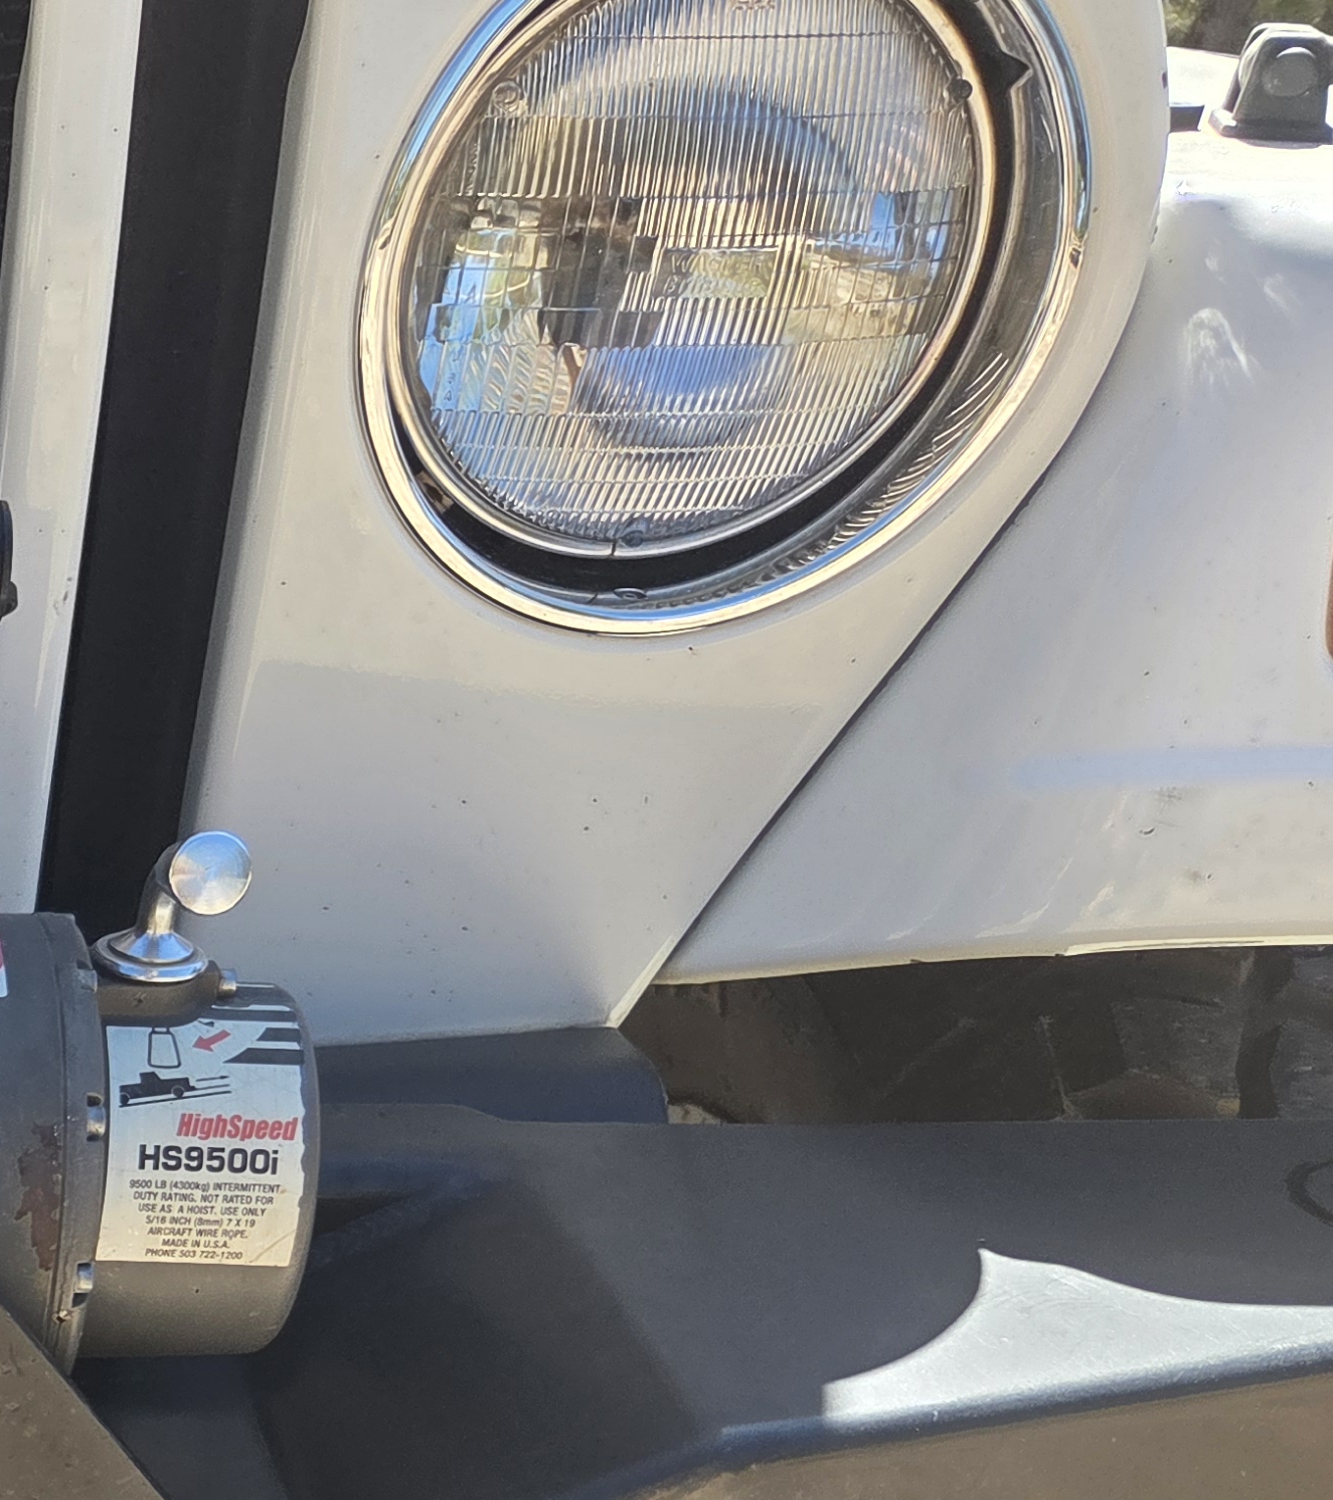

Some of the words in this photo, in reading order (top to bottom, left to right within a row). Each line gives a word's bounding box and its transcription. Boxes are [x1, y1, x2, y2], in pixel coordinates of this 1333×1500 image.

[176, 1113, 299, 1142] HighSpeed
[138, 1144, 279, 1175] HS9500i
[129, 1180, 152, 1189] 9500
[155, 1180, 167, 1189] LB
[169, 1181, 210, 1192] (4300kg)
[213, 1182, 281, 1194] INTERMITTENT
[133, 1191, 158, 1200] DUTY
[160, 1191, 197, 1202] RATING.
[200, 1194, 219, 1203] NOT
[222, 1194, 252, 1204] RATED
[255, 1196, 274, 1205] FOR
[138, 1203, 156, 1213] USE
[159, 1204, 172, 1214] AS
[177, 1205, 184, 1214] A
[186, 1205, 217, 1215] HOIST.
[220, 1206, 238, 1216] USE
[241, 1207, 267, 1217] ONLY
[145, 1215, 166, 1225] 5/16
[169, 1216, 191, 1226] INCH
[193, 1217, 223, 1229] (8mm)
[226, 1218, 233, 1227] 7
[234, 1218, 242, 1227] X
[244, 1218, 256, 1228] 19
[147, 1227, 192, 1237] AIRCRAFT
[195, 1228, 219, 1238] WIRE
[221, 1229, 248, 1240] ROPE.
[161, 1238, 188, 1248] MADE
[191, 1239, 201, 1248] IN
[145, 1248, 176, 1258] PHONE
[178, 1249, 196, 1258] 503
[199, 1250, 243, 1260] 722-1200
